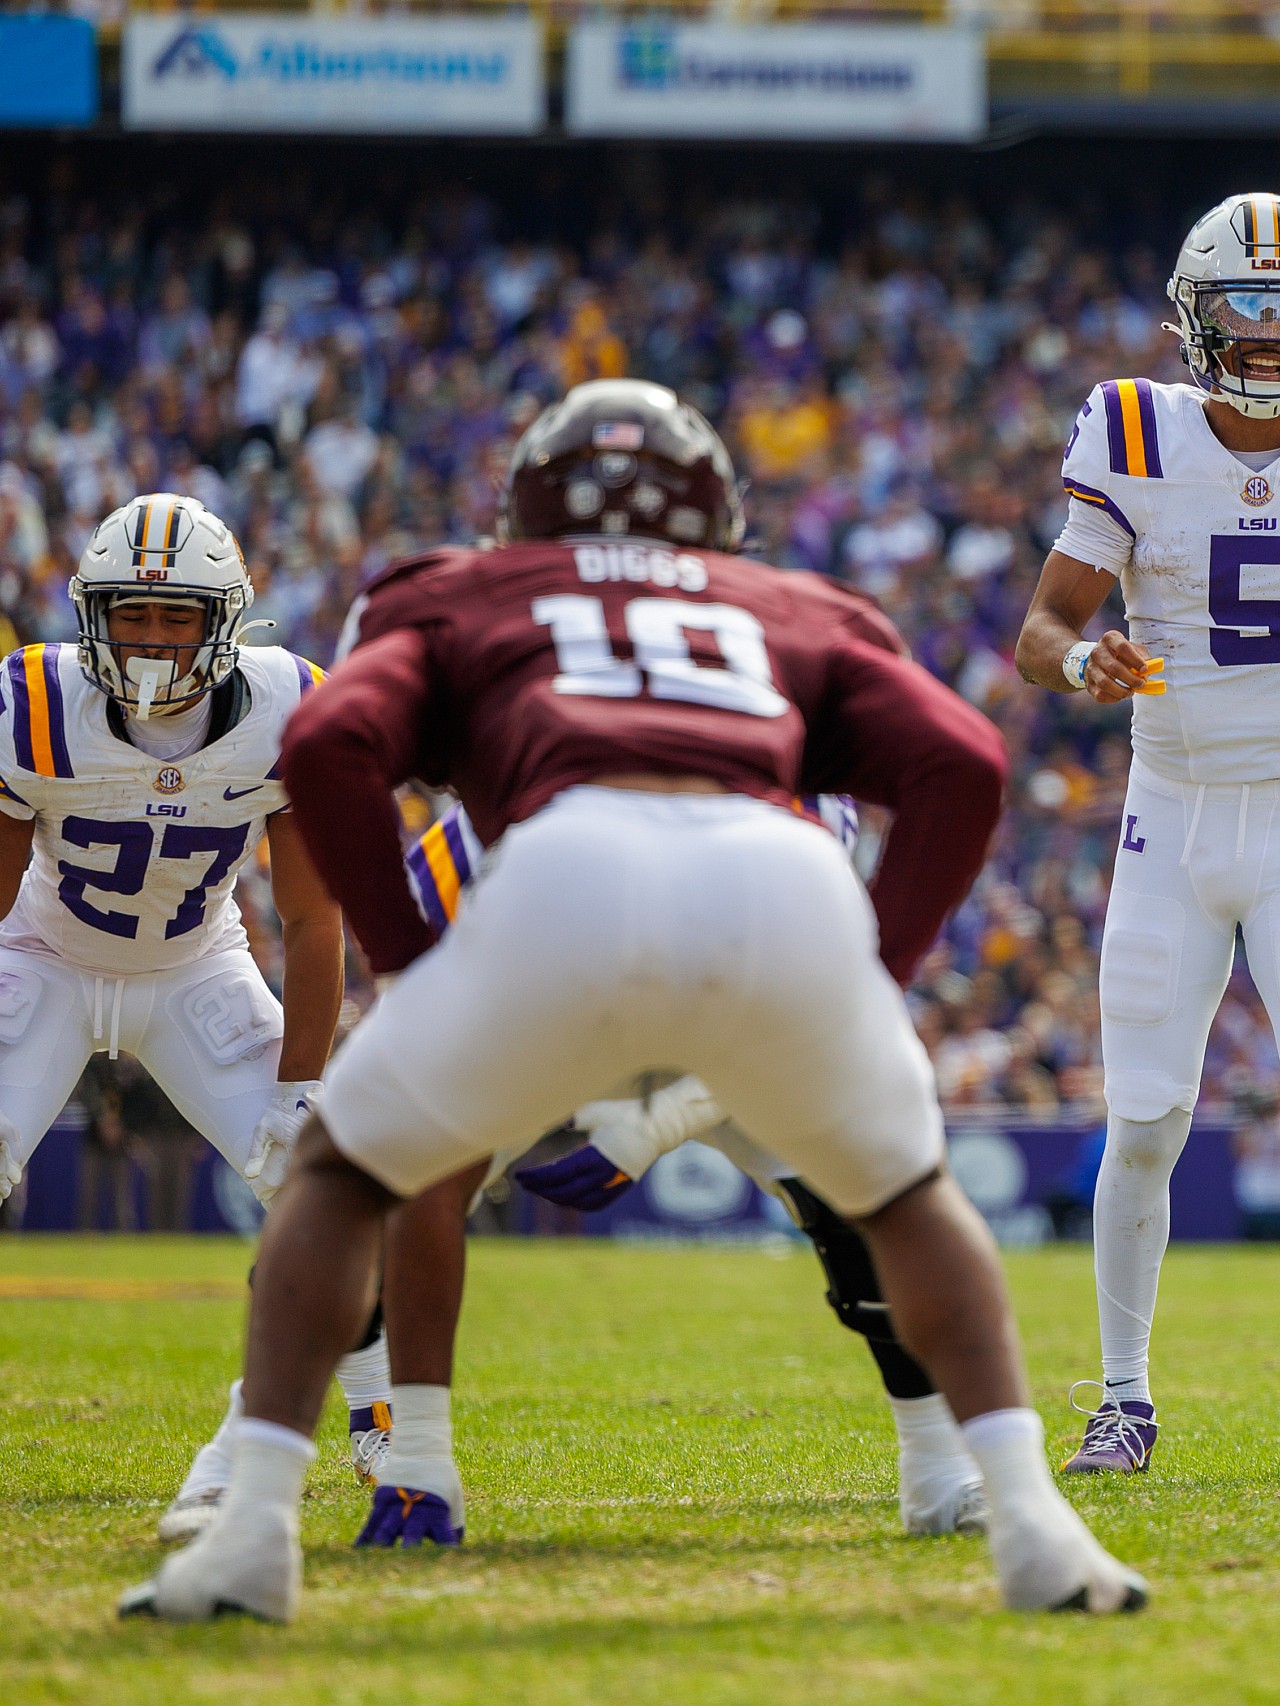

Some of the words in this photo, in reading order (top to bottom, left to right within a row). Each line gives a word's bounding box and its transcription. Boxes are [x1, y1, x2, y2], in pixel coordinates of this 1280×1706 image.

[1246, 477, 1268, 499] SEC
[1238, 517, 1278, 531] LSU
[136, 569, 168, 582] LSU
[572, 545, 709, 592] DIGGS
[530, 592, 790, 718] 10
[159, 768, 181, 788] SEC
[145, 803, 187, 817] LSU
[1122, 814, 1147, 854] L
[58, 816, 250, 940] 27
